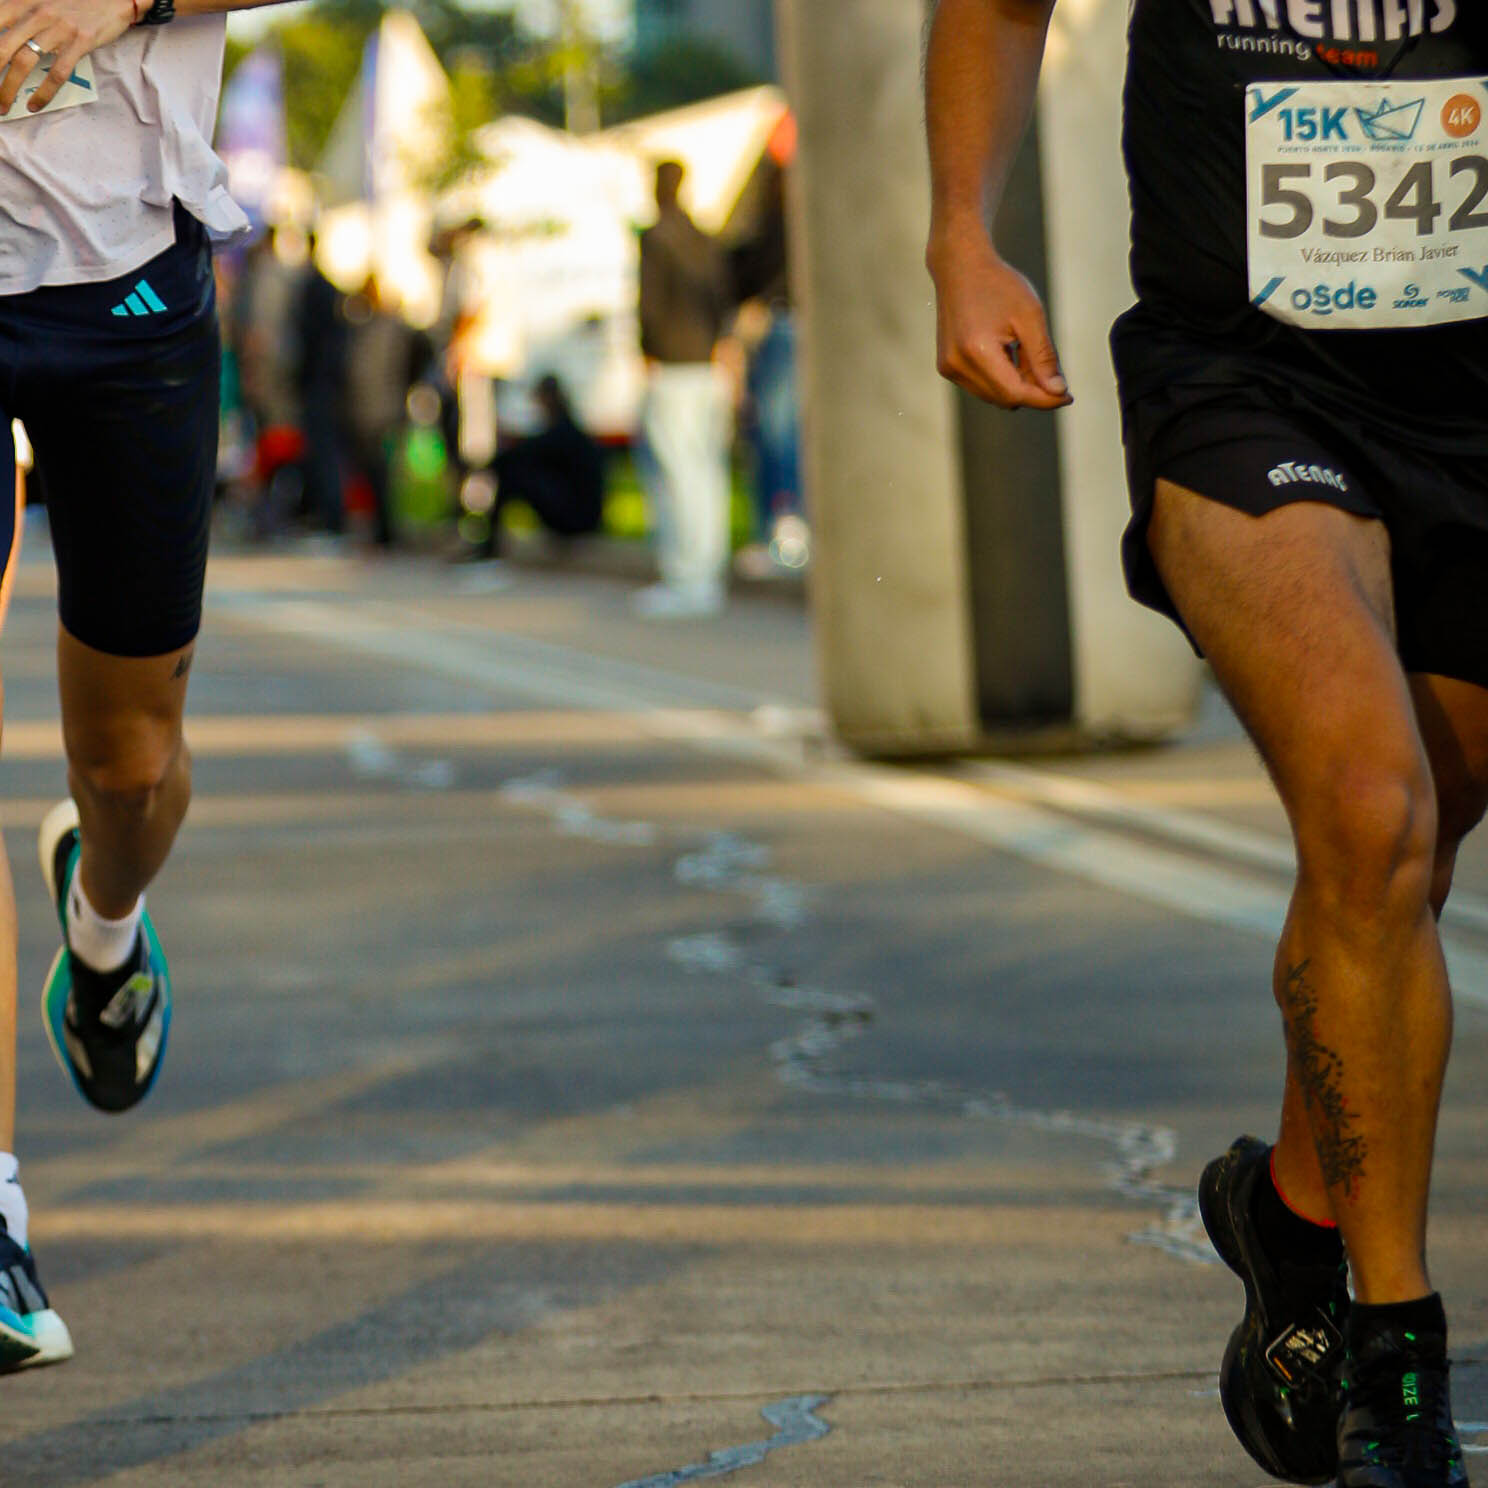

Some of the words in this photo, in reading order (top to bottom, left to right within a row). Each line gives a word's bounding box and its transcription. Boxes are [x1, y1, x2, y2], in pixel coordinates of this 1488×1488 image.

[1216, 32, 1311, 61] running
[1315, 42, 1378, 68] team
[1278, 106, 1349, 141] 15K
[1448, 108, 1474, 125] 4K
[1258, 155, 1488, 239] 5342
[1300, 247, 1368, 266] Vázquez
[1372, 247, 1415, 262] Brian
[1419, 244, 1460, 261] Javier
[1290, 281, 1377, 315] osde
[1267, 461, 1348, 492] ATENAS
